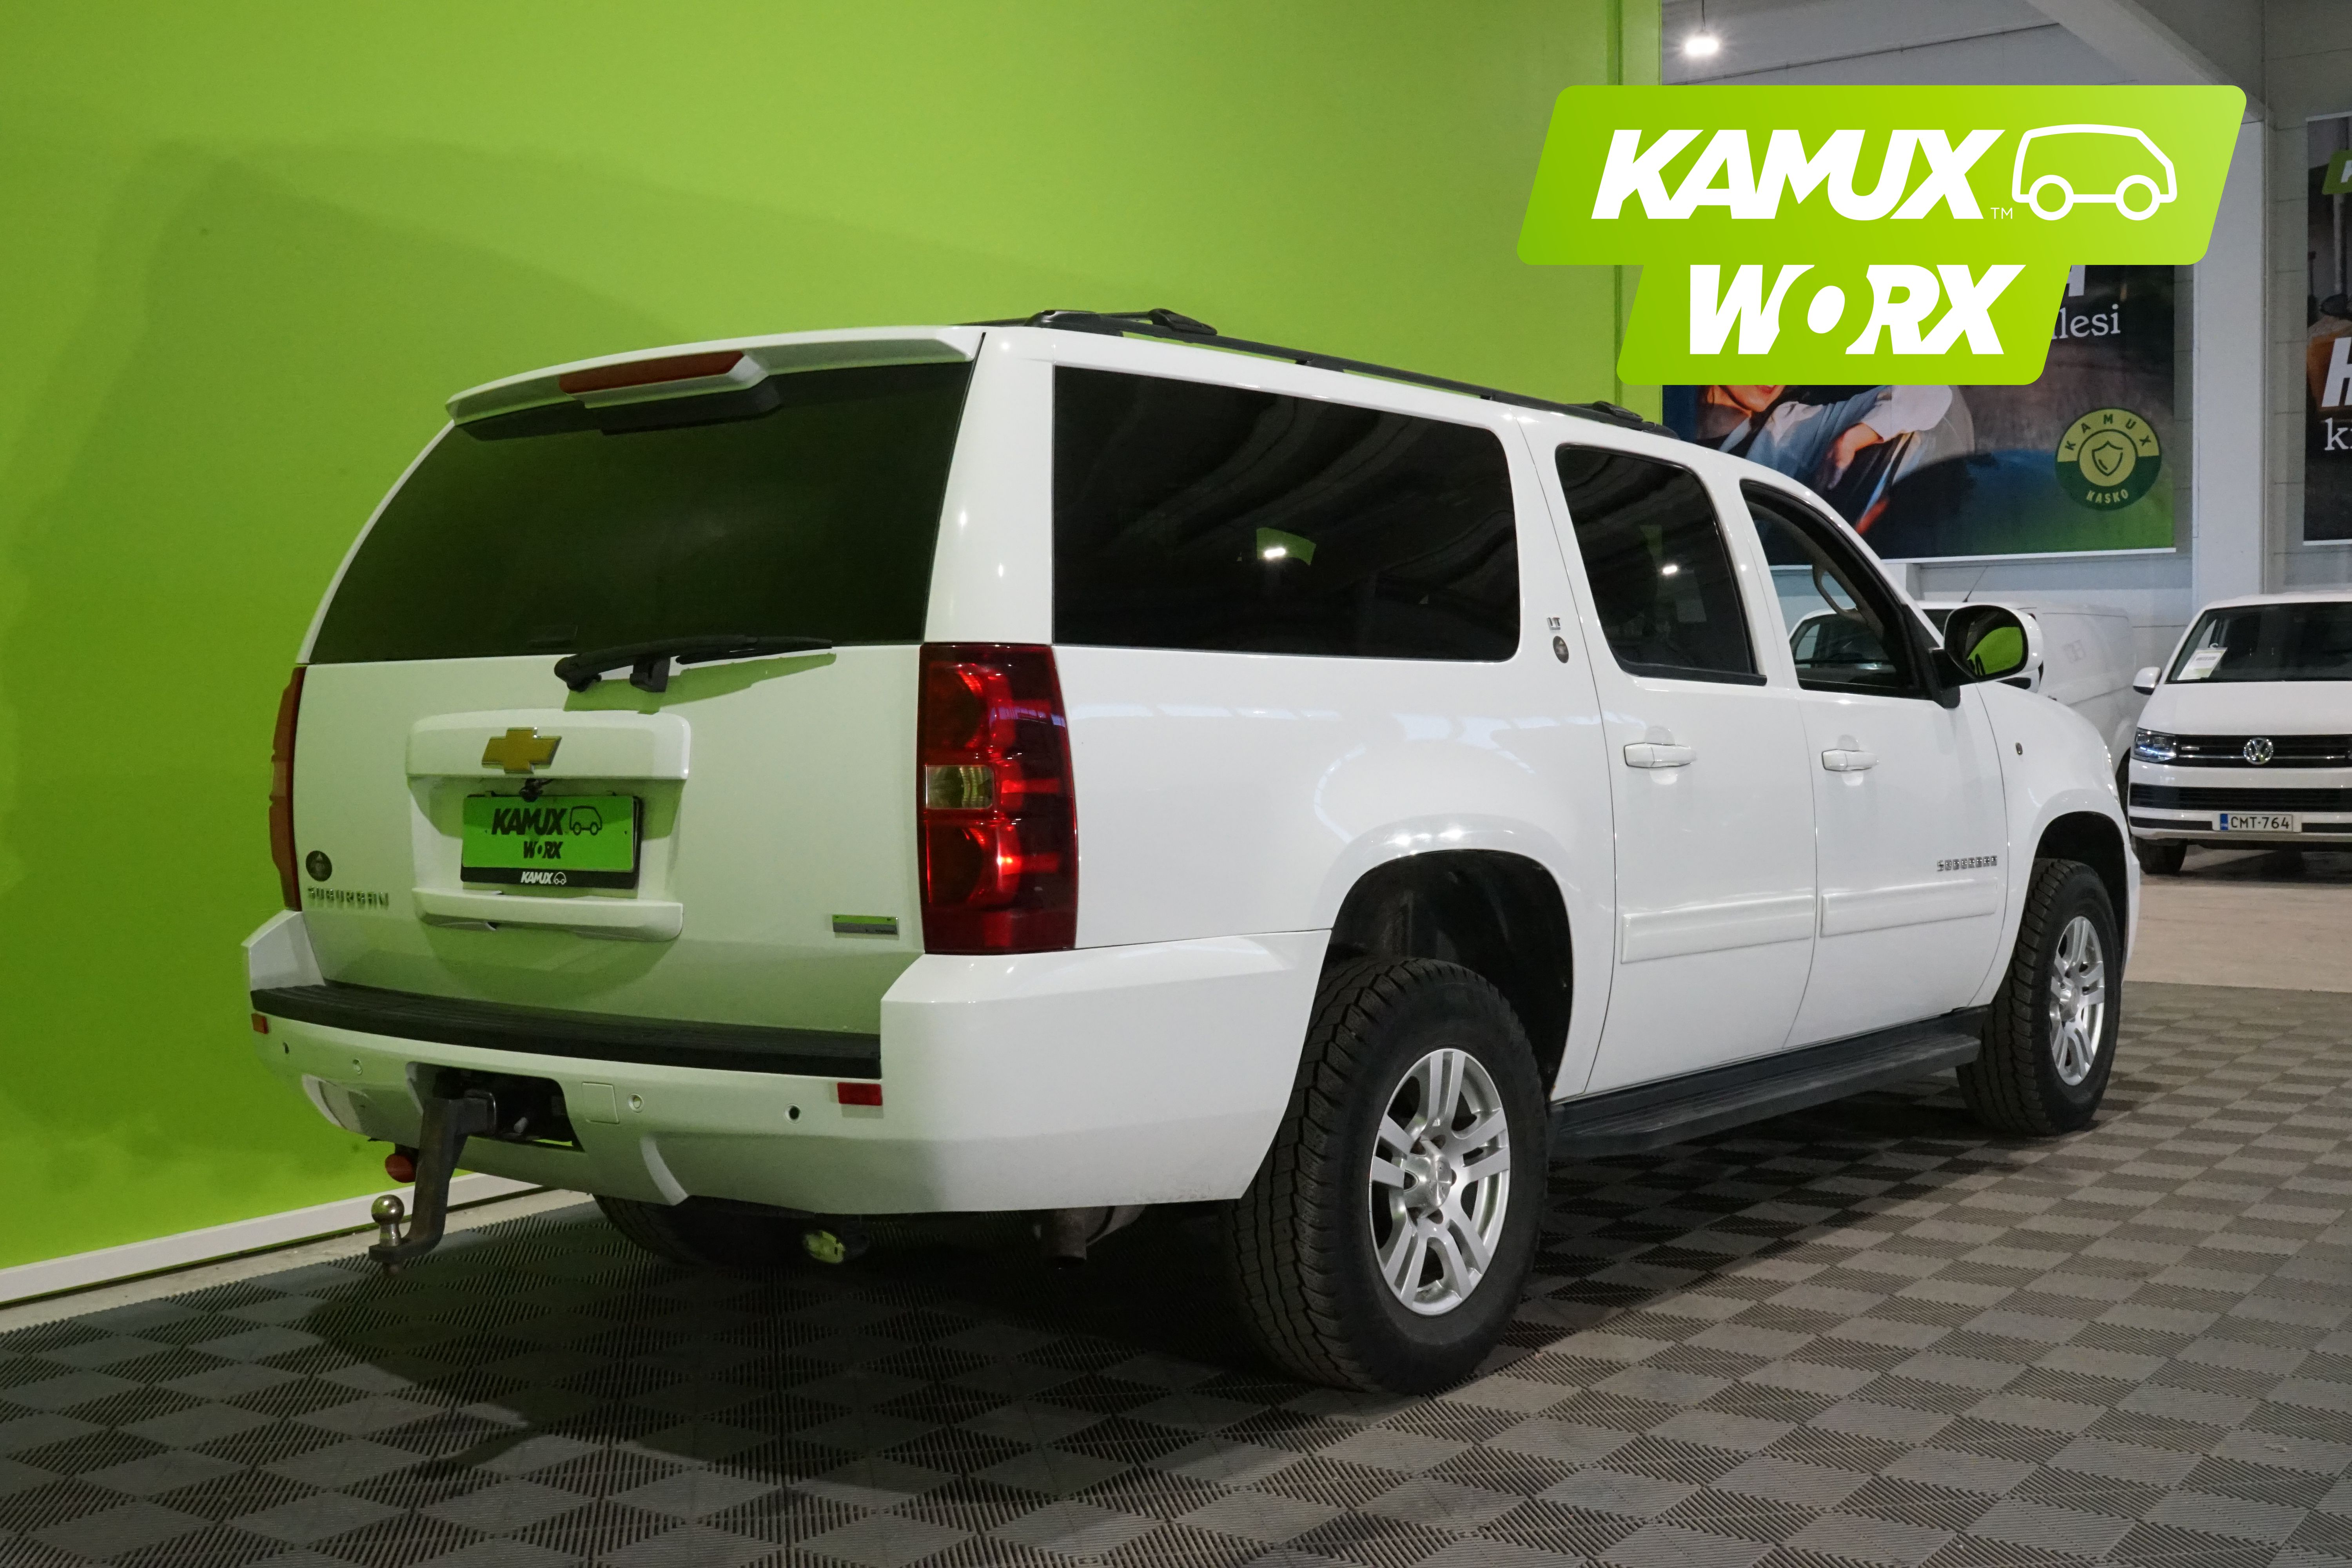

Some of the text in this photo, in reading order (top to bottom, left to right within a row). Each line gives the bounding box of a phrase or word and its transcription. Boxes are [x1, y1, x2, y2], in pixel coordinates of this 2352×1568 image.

[2051, 303, 2121, 339] lesi
[2064, 414, 2152, 451] KAMUX
[2086, 489, 2129, 504] KASKO
[491, 808, 567, 835] KAMUX
[2230, 816, 2289, 829] CMT-764
[523, 841, 564, 859] WORX
[521, 871, 554, 884] KAMUX
